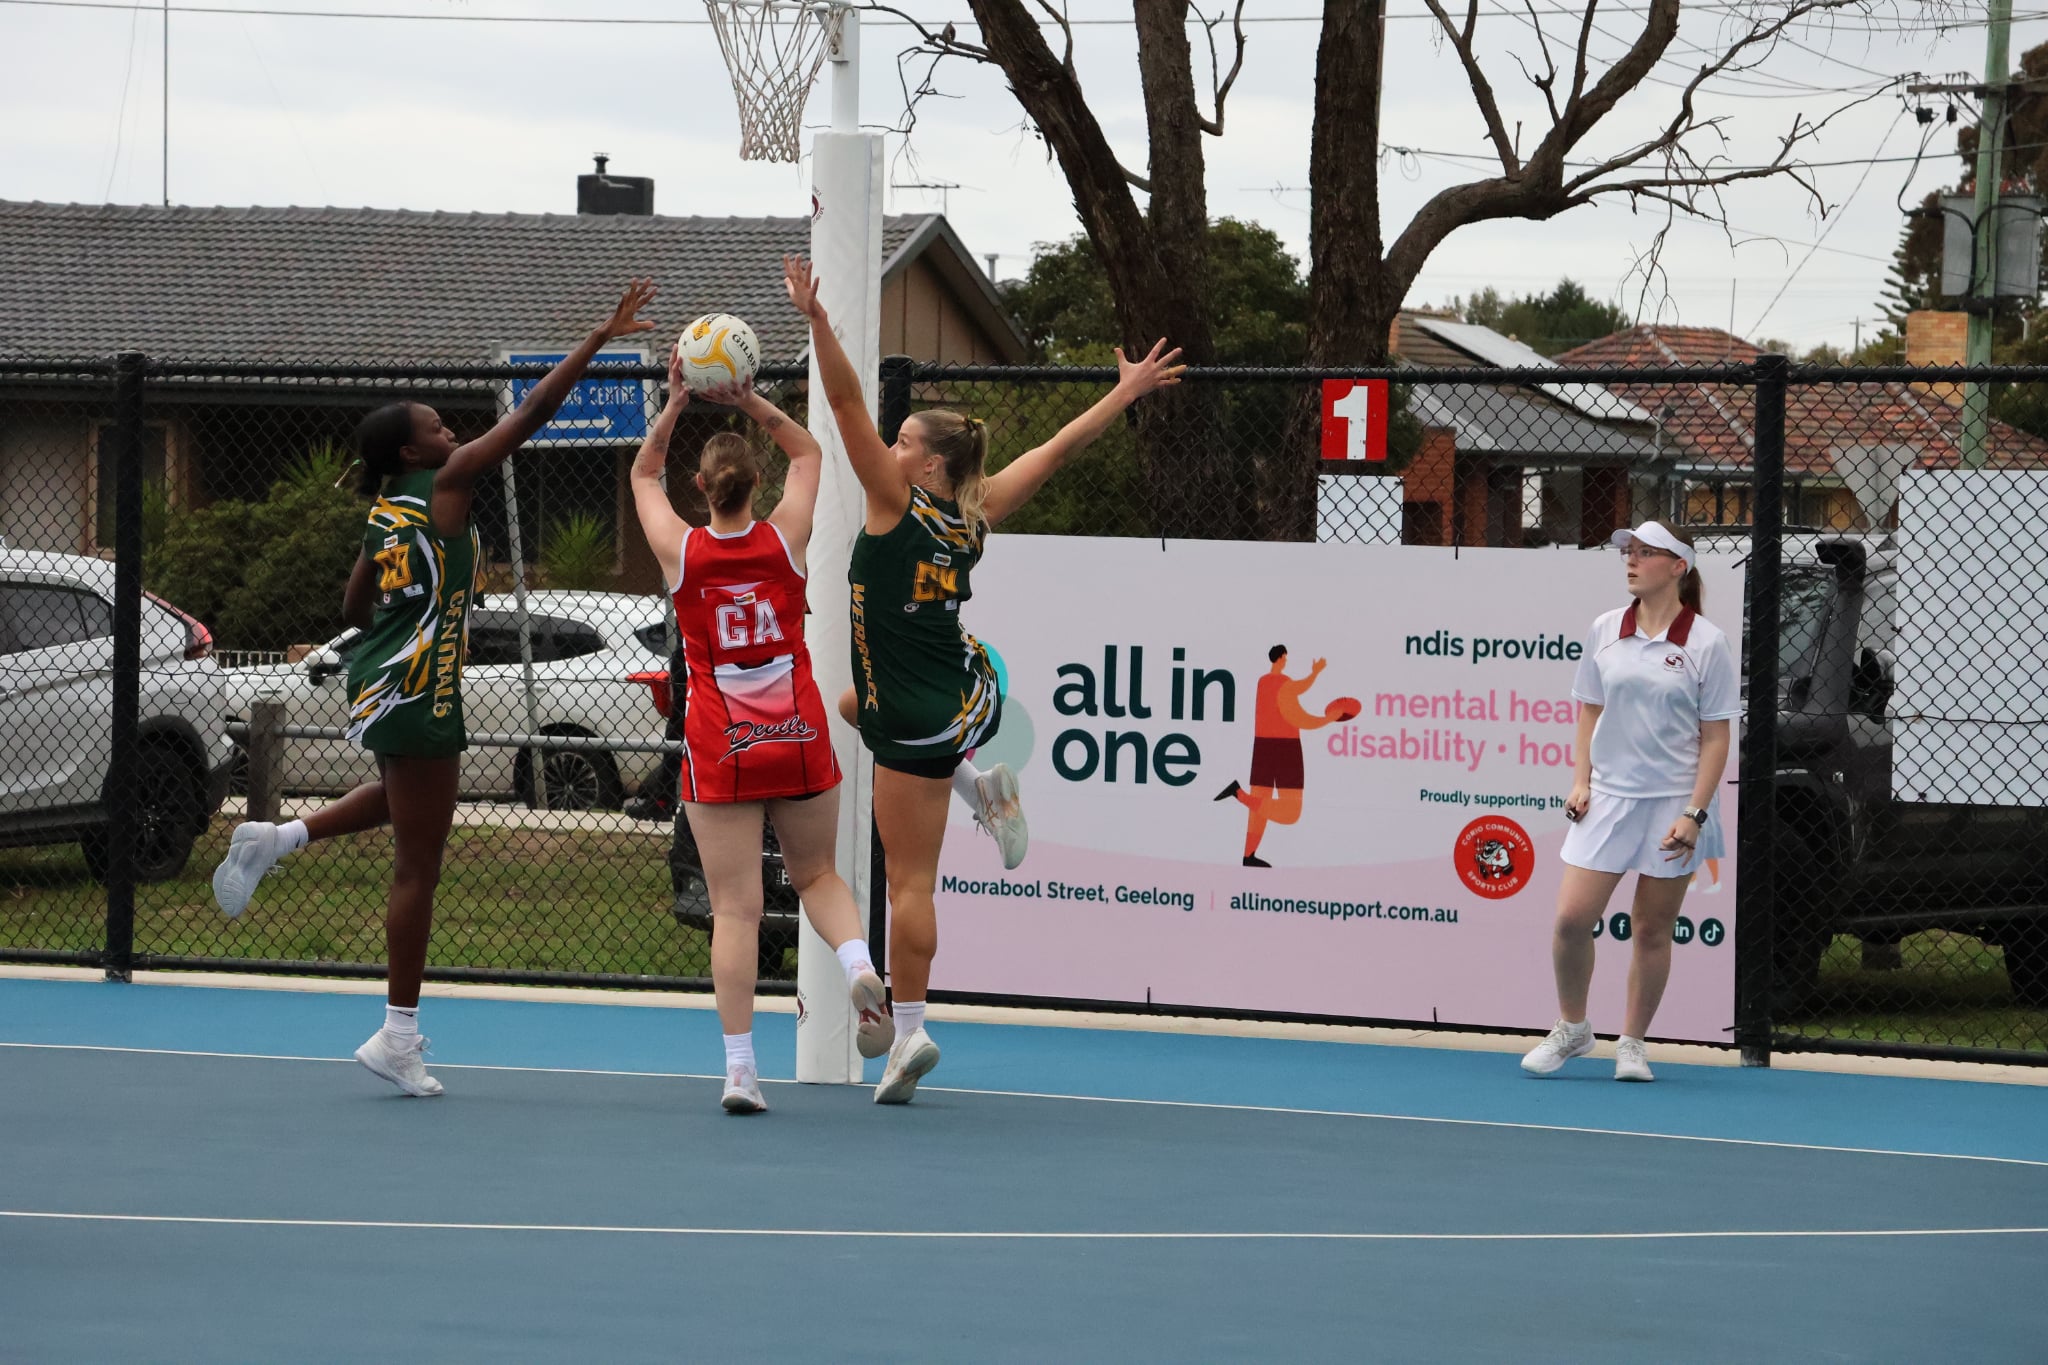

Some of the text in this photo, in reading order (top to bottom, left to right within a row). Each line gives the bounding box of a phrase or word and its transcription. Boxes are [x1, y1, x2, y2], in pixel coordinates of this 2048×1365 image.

[590, 386, 636, 405] CENTRE
[1333, 385, 1368, 460] 1
[715, 599, 784, 650] GA
[433, 590, 465, 718] CENTRALS
[1405, 630, 1464, 657] ndis
[1053, 645, 1235, 722] all in
[1374, 689, 1499, 721] mental
[723, 715, 817, 748] Devils
[1052, 728, 1201, 786] one
[1327, 726, 1486, 772] disability
[1420, 789, 1567, 810] Proudly supporting th
[1461, 824, 1529, 852] CORIO COMMUNITY
[942, 875, 1195, 911] Moorabool Street, Geelong
[1467, 871, 1519, 892] SPORTS CLUB
[1230, 892, 1459, 923] allinonesupport.com.au
